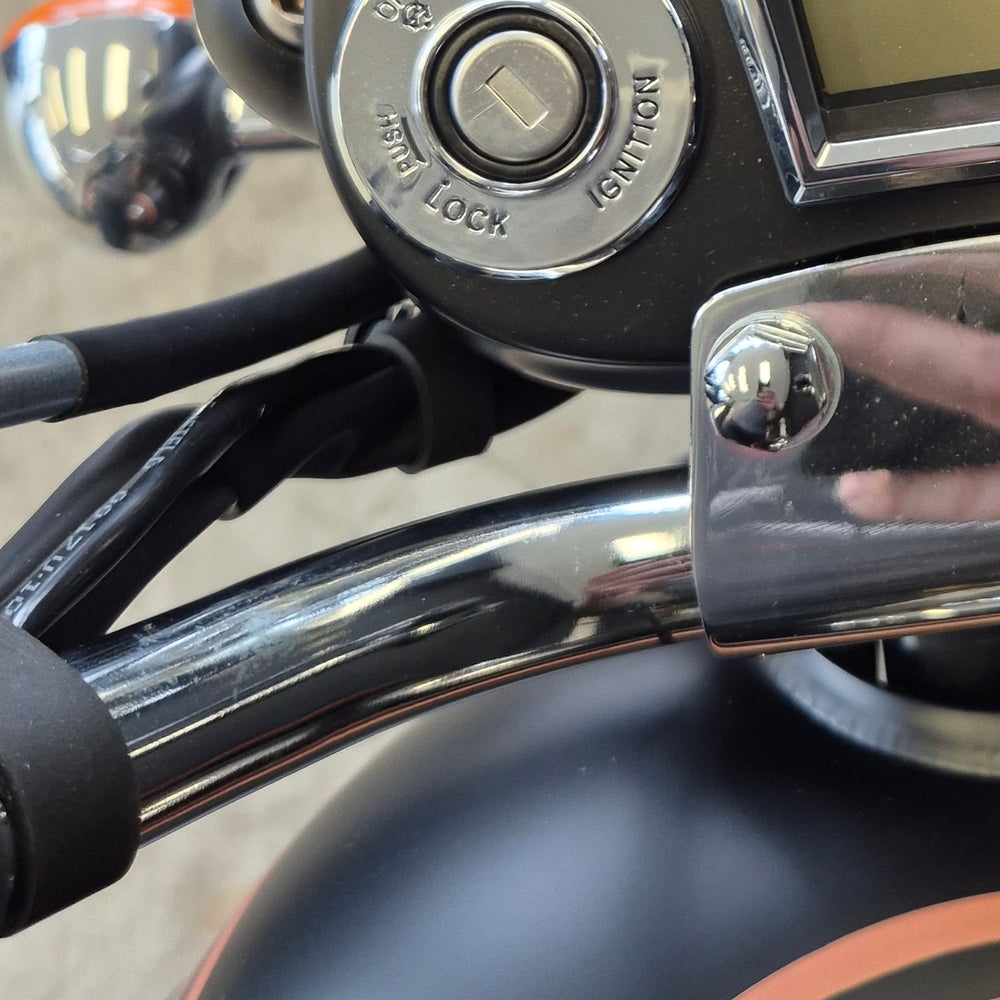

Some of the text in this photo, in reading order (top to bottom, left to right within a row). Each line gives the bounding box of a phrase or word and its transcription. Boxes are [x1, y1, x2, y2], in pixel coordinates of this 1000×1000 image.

[376, 103, 419, 178] PUSH
[586, 74, 660, 213] IGNITION
[423, 180, 511, 238] LOCK
